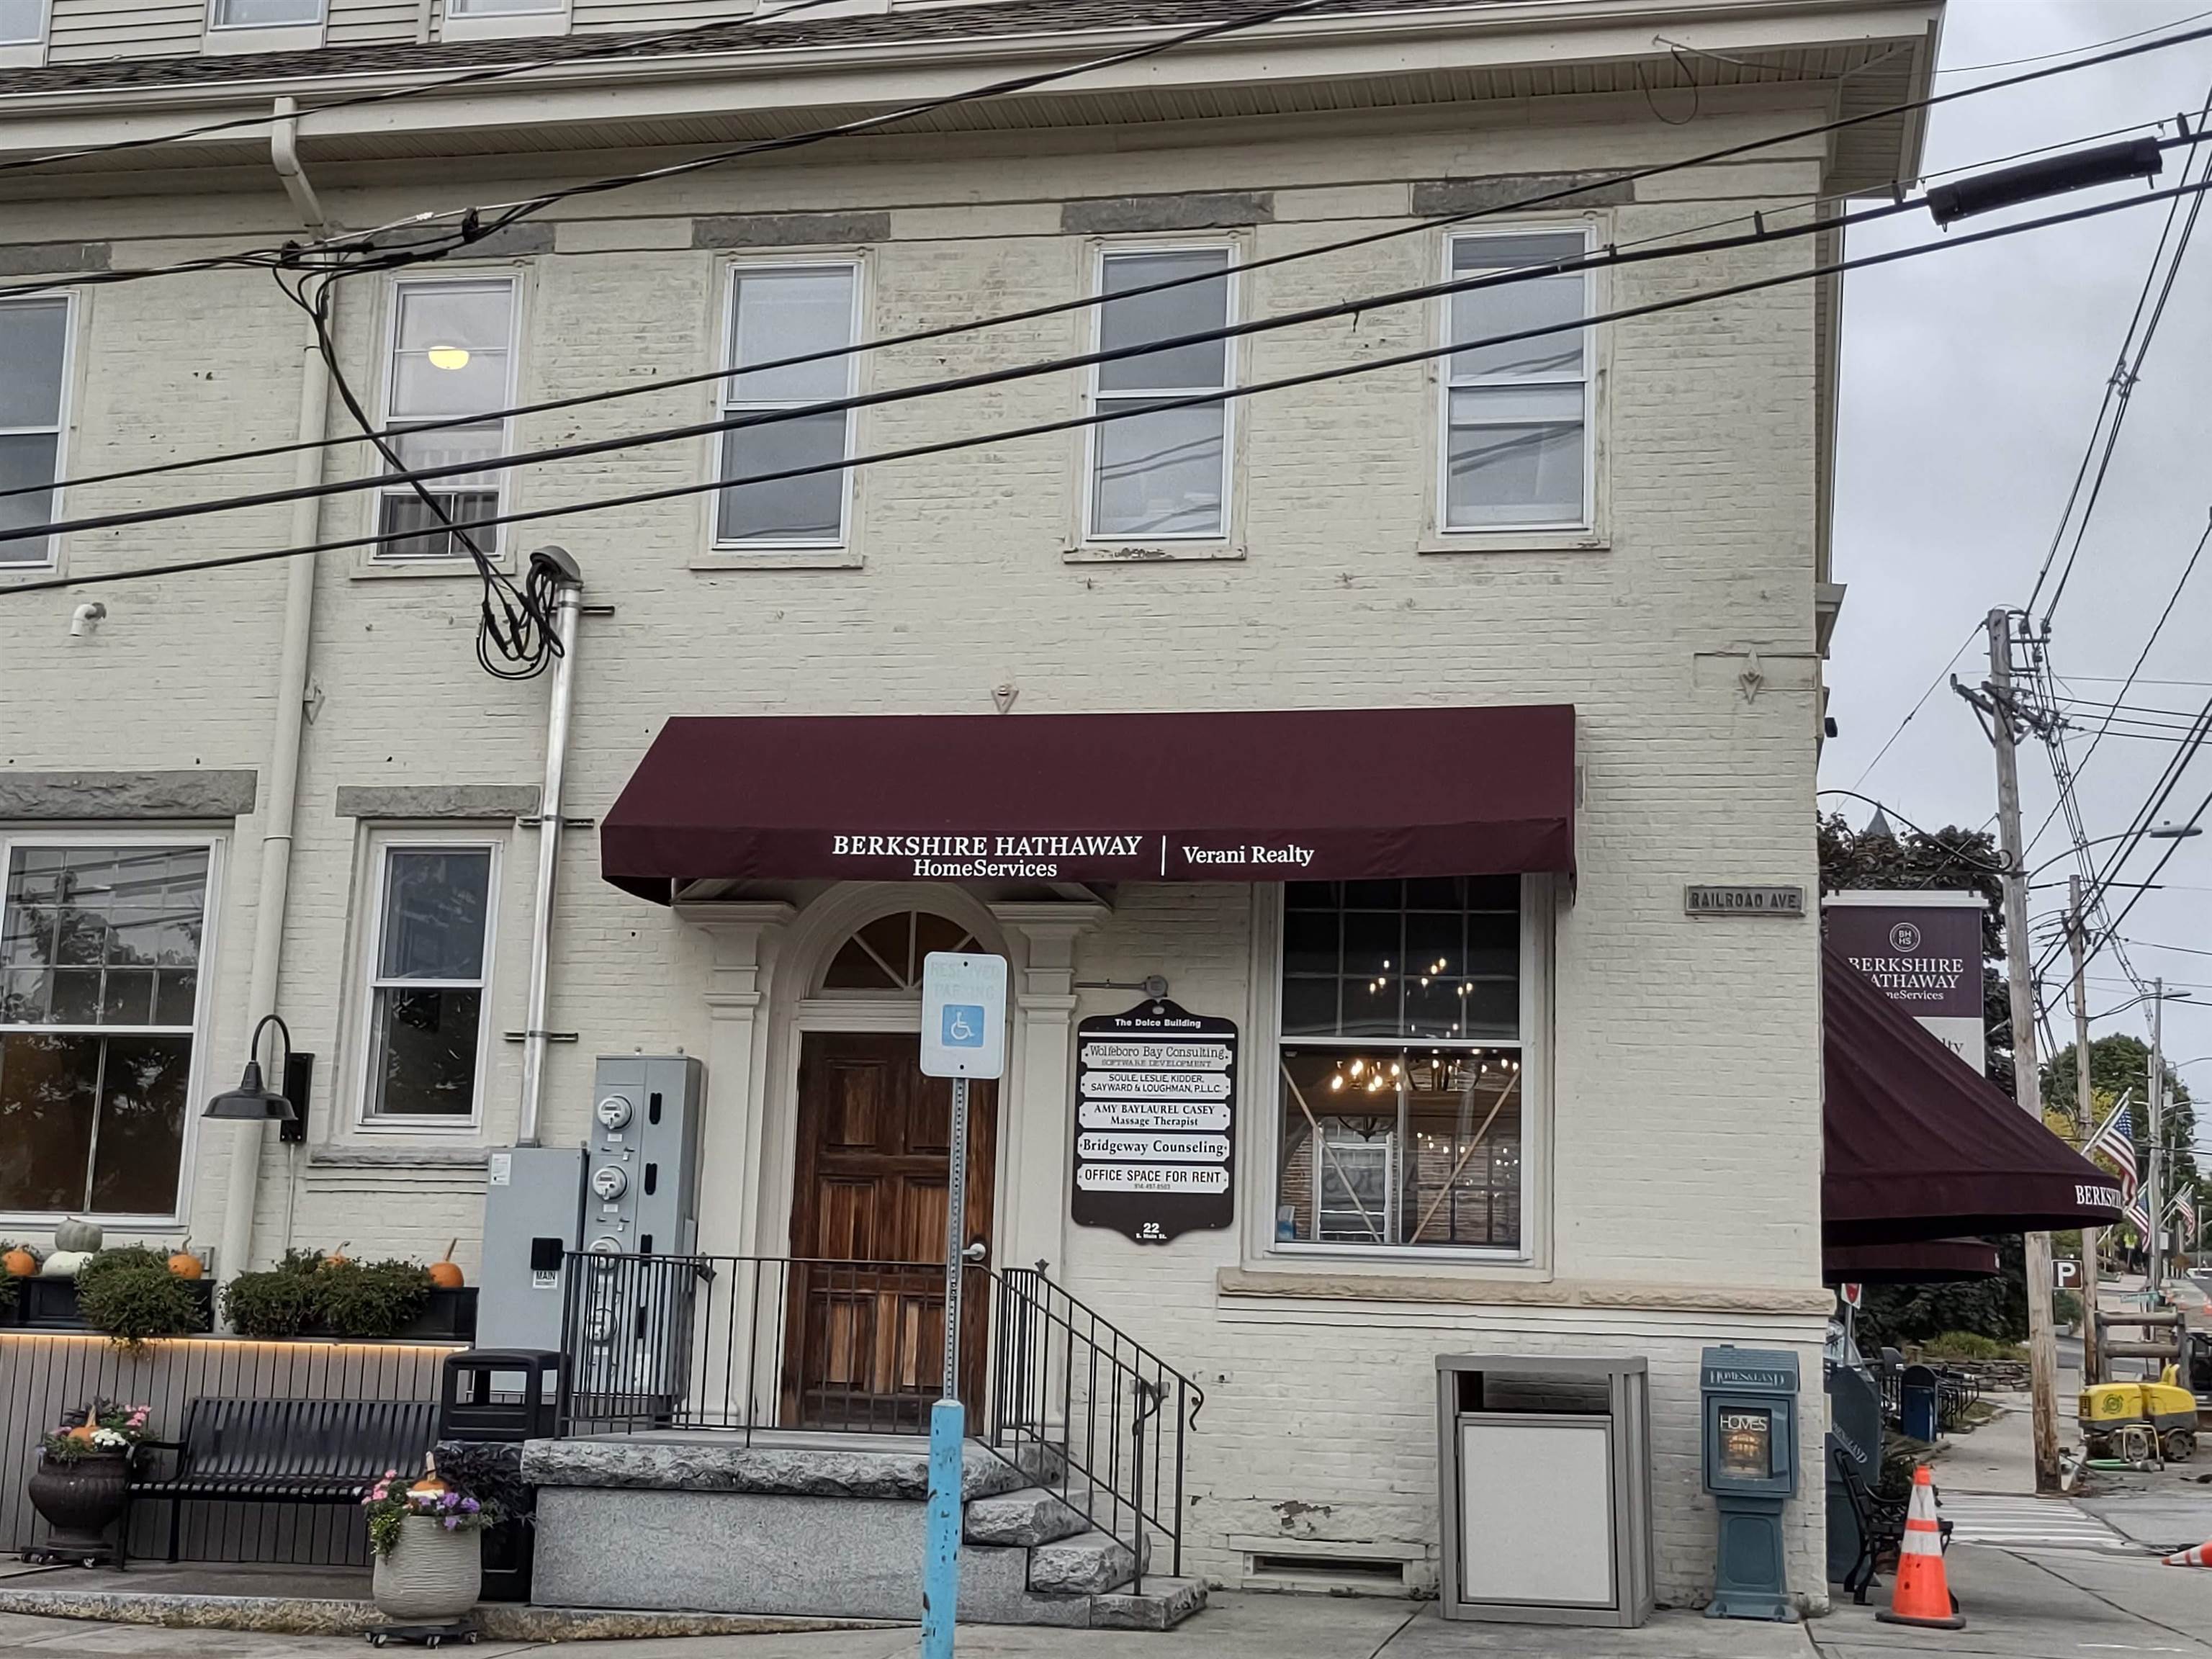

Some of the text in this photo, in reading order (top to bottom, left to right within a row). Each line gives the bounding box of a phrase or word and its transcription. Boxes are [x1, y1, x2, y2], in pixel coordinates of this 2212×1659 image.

[832, 835, 1143, 856] BERKSHIRE HATHAWAY
[1182, 844, 1315, 867] Verani Realty
[912, 859, 1057, 877] HomeServices
[1691, 891, 1763, 908] RAILROAD
[1868, 974, 1960, 989] ATHAWAY
[1115, 1018, 1202, 1029] The Dolce Building
[1090, 1045, 1225, 1060] Wolfeboro Bay Consulting
[1101, 1058, 1212, 1068] SOFTWARE DEVELOPMENT
[1091, 1083, 1133, 1092] SAYWARD
[1135, 1084, 1141, 1092] &
[1142, 1084, 1192, 1094] LOUGHMAN,
[1094, 1105, 1215, 1115] AMY BAYLAUREL CASEY
[1110, 1116, 1198, 1128] Massage Therapist
[1083, 1138, 1223, 1156] Bridgeway Counseling
[1085, 1169, 1221, 1183] OFFICE SPACE FOR RENT
[1143, 1222, 1160, 1233] 22
[2057, 1262, 2076, 1287] P
